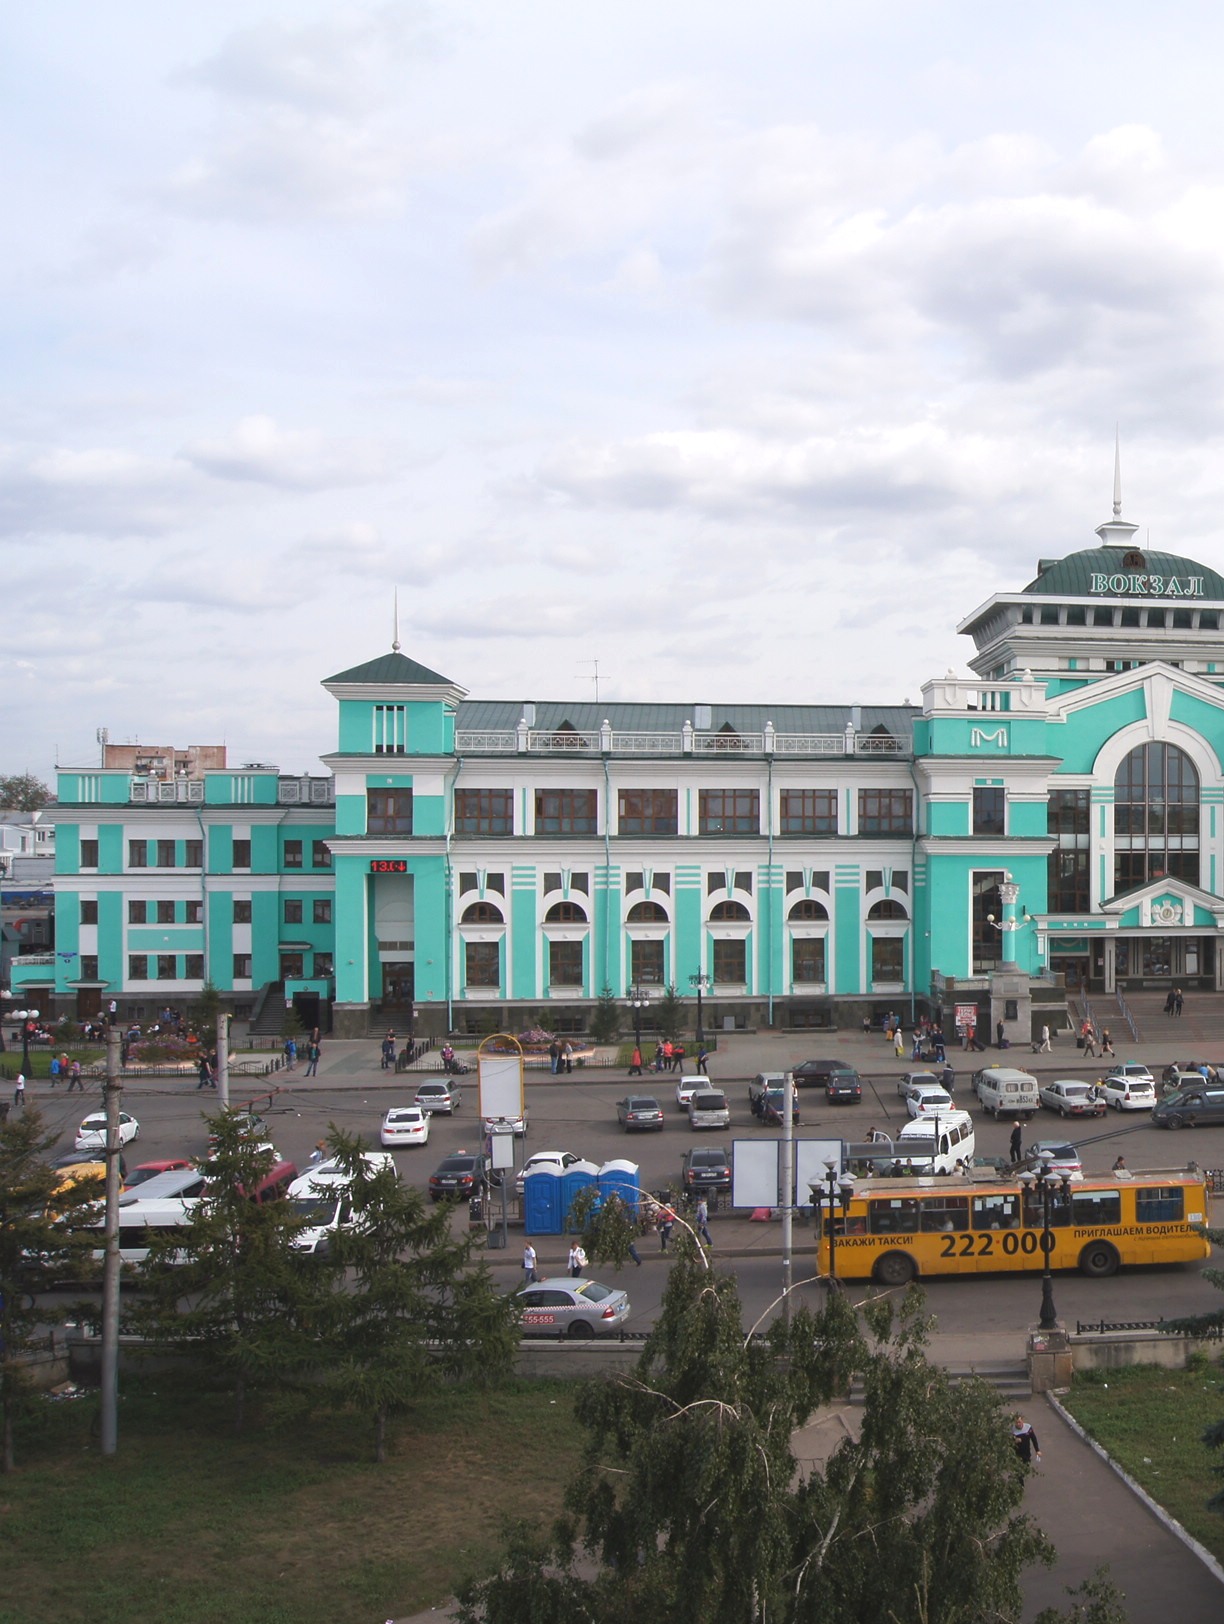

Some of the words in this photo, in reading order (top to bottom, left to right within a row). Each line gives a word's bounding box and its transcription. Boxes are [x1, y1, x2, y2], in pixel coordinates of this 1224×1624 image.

[1090, 573, 1204, 595] ВОКЗАЛ
[1074, 1226, 1144, 1239] ПРИГЛАШАЕМ
[1146, 1224, 1195, 1236] ВОДИТЕЛ
[833, 1237, 876, 1248] ЗАКАЖИ
[878, 1236, 913, 1246] ТАКСИ!
